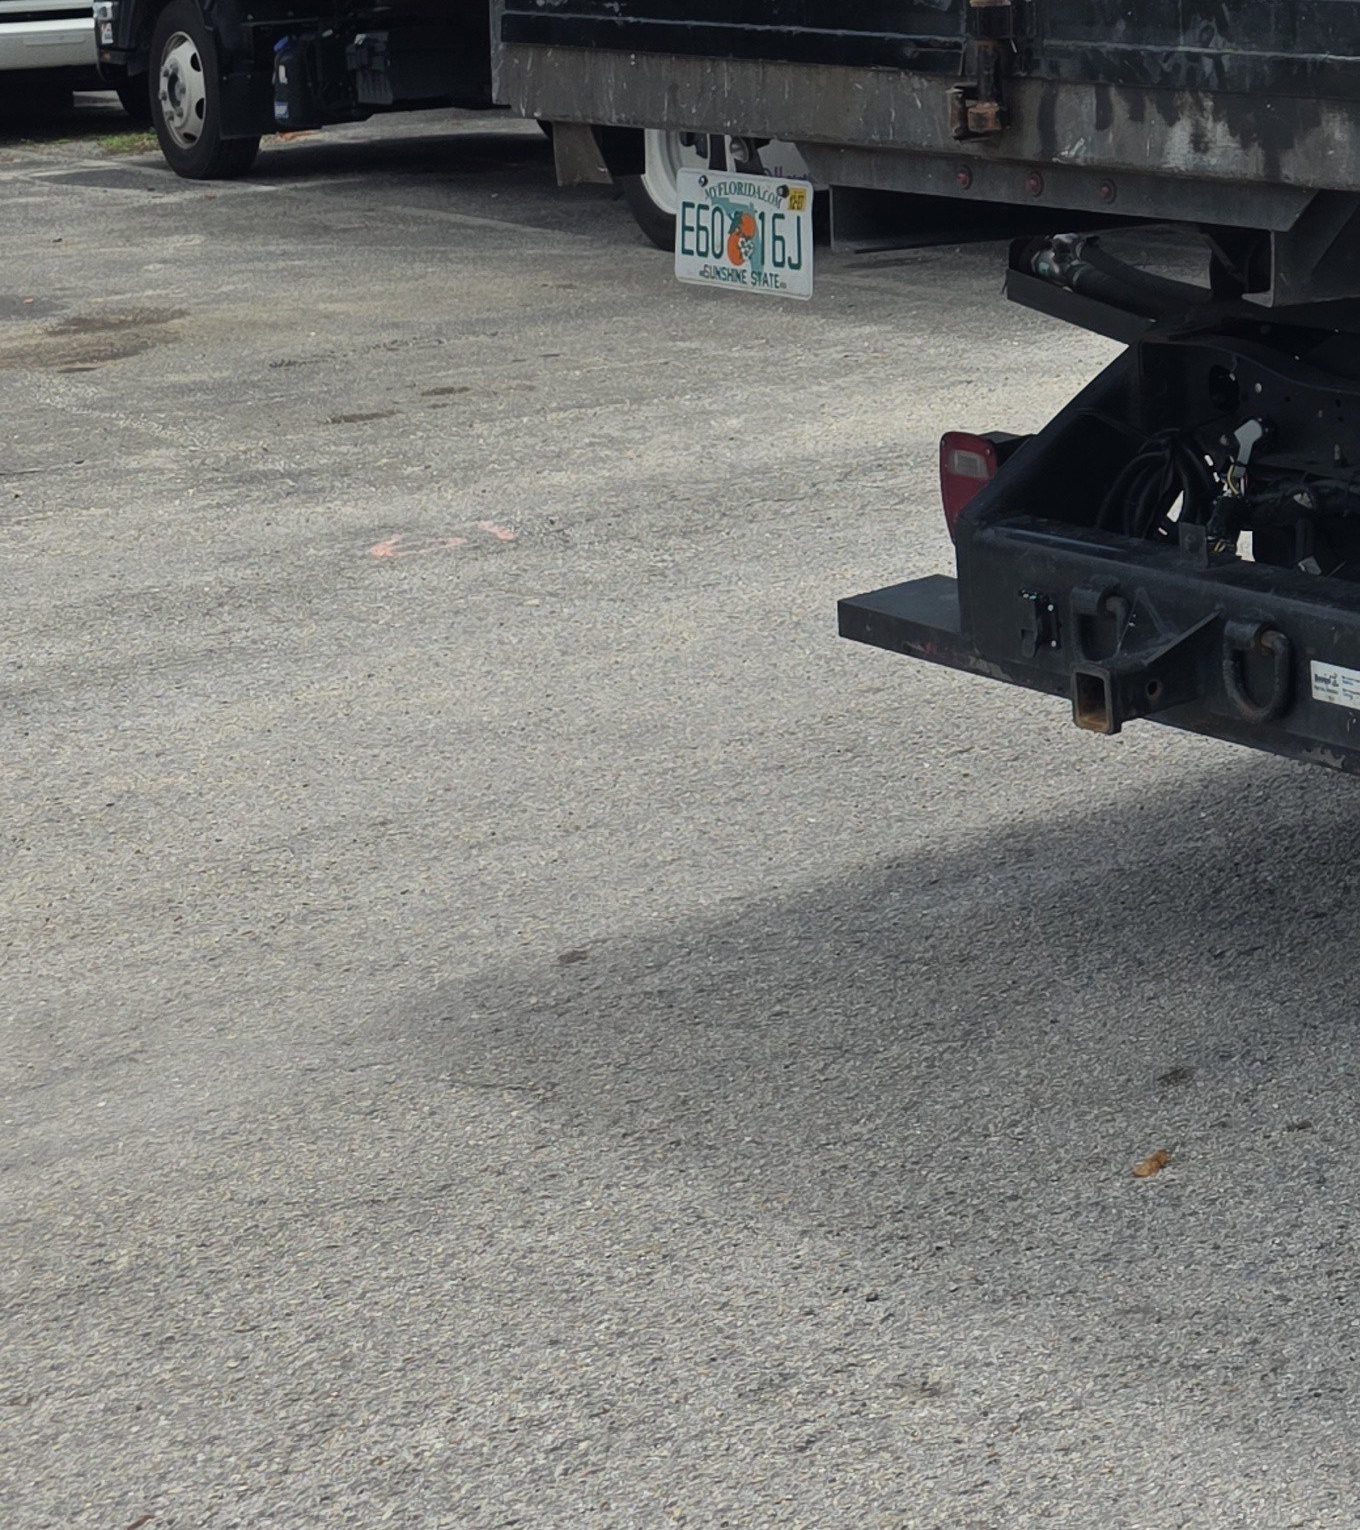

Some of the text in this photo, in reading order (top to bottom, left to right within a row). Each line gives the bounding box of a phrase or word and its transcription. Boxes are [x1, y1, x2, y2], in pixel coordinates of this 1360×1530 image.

[681, 200, 803, 271] E60 16J
[702, 263, 781, 289] SUNSHINE STATE
